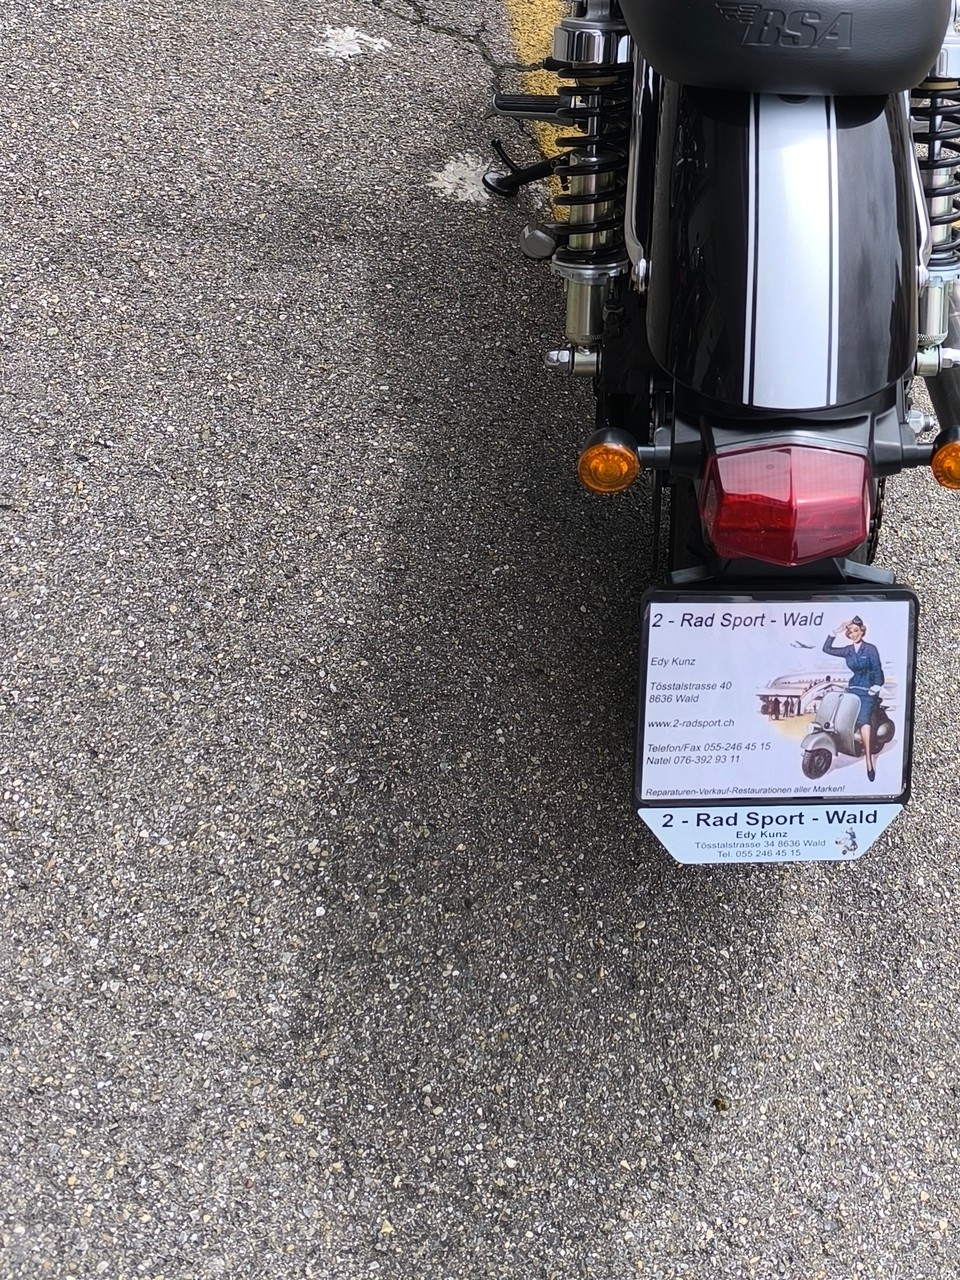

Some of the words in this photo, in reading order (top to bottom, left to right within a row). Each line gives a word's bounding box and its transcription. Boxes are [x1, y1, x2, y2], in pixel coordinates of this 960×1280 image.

[741, 6, 852, 49] BSA
[652, 613, 663, 628] 2
[680, 613, 715, 628] Rad
[720, 612, 766, 630] Sport
[783, 612, 824, 627] Wald
[650, 657, 670, 667] Edy
[671, 657, 696, 666] Kunz
[650, 681, 717, 691] Tösstalstrasse
[719, 682, 732, 690] 40
[649, 695, 673, 703] 8636
[676, 694, 700, 703] Wald
[648, 718, 735, 729] www.2-radsport.ch
[647, 743, 701, 753] Telefon/Fax
[703, 742, 742, 752] 055-246
[744, 742, 757, 750] 45
[760, 742, 771, 750] 15
[646, 756, 671, 765] Natel
[673, 755, 712, 764] 076-392
[715, 755, 727, 763] 93
[731, 755, 740, 763] 11
[646, 786, 792, 796] Reparaturen-Verkauf-Restaurationen
[793, 785, 811, 793] aller
[812, 785, 845, 793] Marken!
[662, 814, 674, 827] 2
[696, 812, 738, 827] Rad
[746, 811, 804, 829] Sport
[825, 810, 878, 824] Wald
[736, 831, 757, 840] Edy
[760, 830, 788, 838] Kunz
[695, 841, 761, 849] Tösstalstrasse
[803, 839, 826, 847] Wald
[717, 850, 733, 858] Tel.
